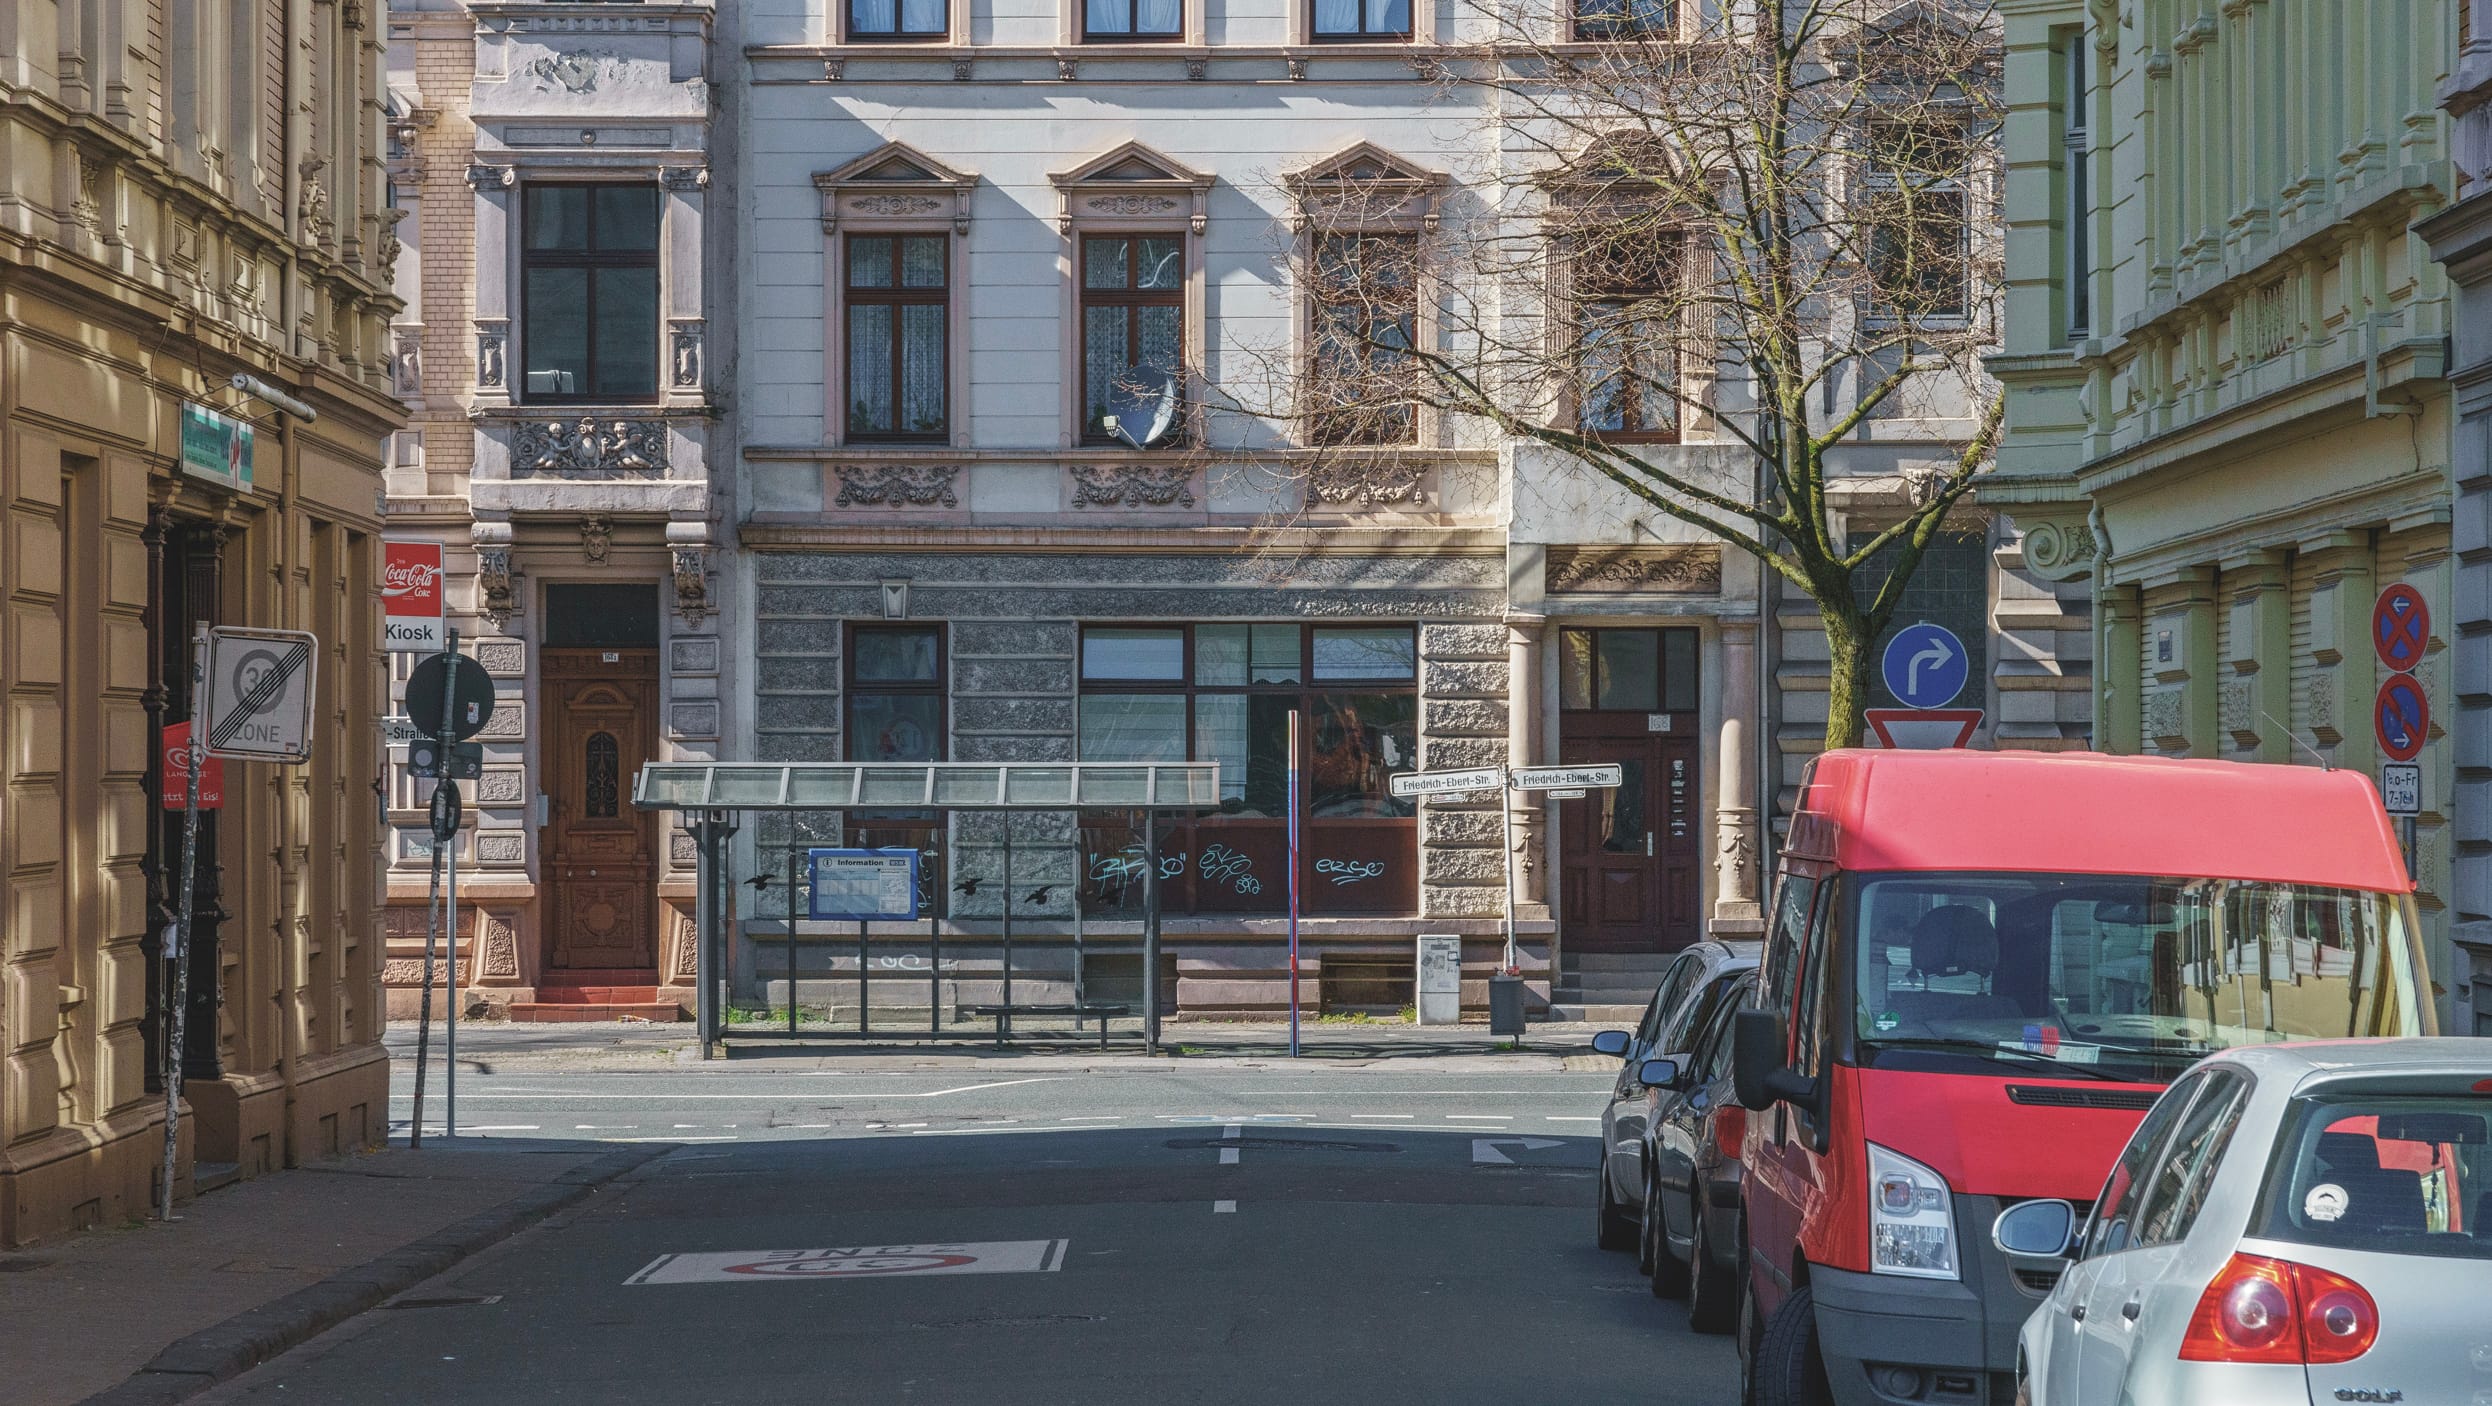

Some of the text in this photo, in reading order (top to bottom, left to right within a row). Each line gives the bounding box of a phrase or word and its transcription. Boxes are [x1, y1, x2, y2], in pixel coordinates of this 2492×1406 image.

[385, 562, 432, 587] Coca-Cola
[385, 623, 433, 640] Kiosk
[166, 770, 208, 778] LANGSE
[1403, 774, 1491, 791] Friedrich-Ebert-Str.
[1523, 771, 1611, 786] Friedrich-Ebert-Str.
[837, 859, 884, 867] Information
[2334, 1386, 2404, 1404] GOLF
